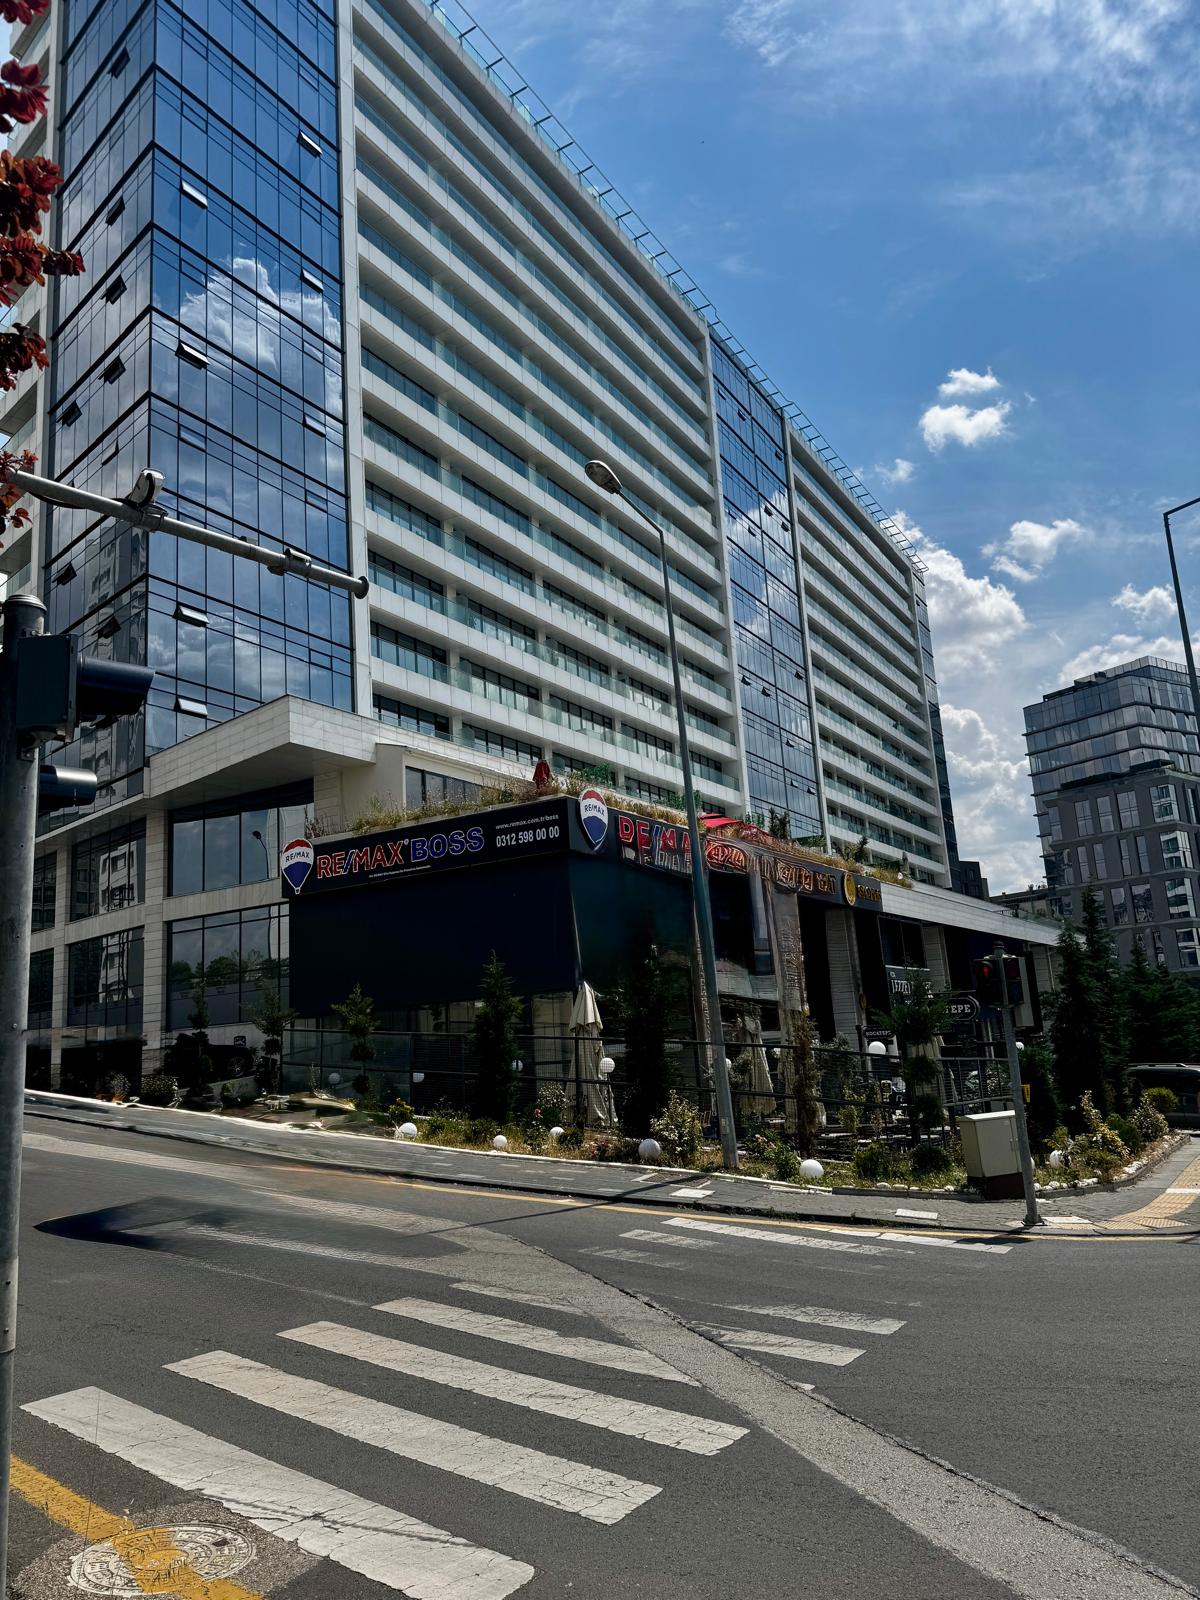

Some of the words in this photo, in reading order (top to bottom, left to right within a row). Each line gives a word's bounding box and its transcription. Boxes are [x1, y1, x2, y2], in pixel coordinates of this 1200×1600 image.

[584, 803, 605, 816] RE/MAX
[496, 832, 517, 848] 0312
[518, 829, 534, 844] 598
[535, 827, 547, 841] 00
[548, 825, 560, 839] 00
[285, 851, 310, 863] RE/MAX
[316, 840, 405, 879] RE/MAX
[410, 826, 485, 863] BOSS
